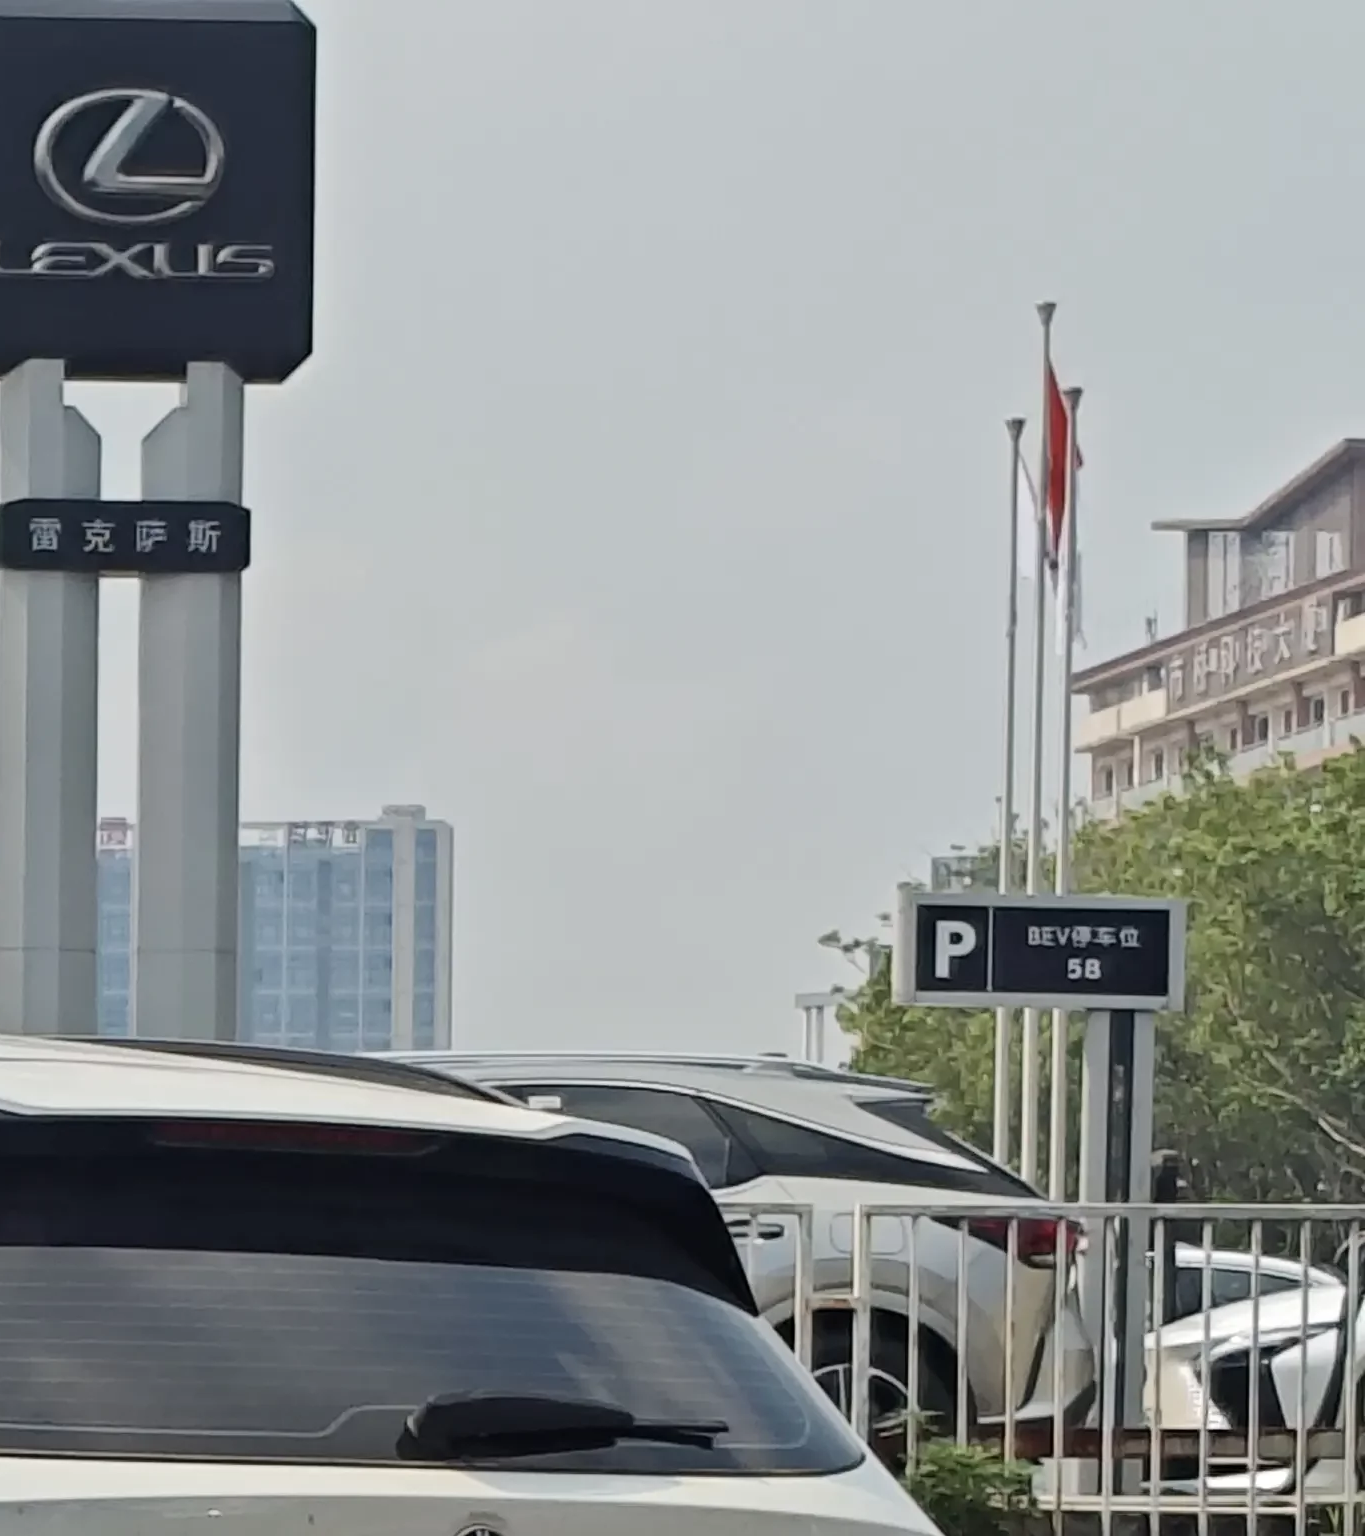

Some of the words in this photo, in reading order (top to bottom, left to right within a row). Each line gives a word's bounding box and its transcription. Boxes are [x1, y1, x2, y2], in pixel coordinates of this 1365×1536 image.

[28, 517, 222, 553] 雷克萨斯
[934, 919, 977, 979] P
